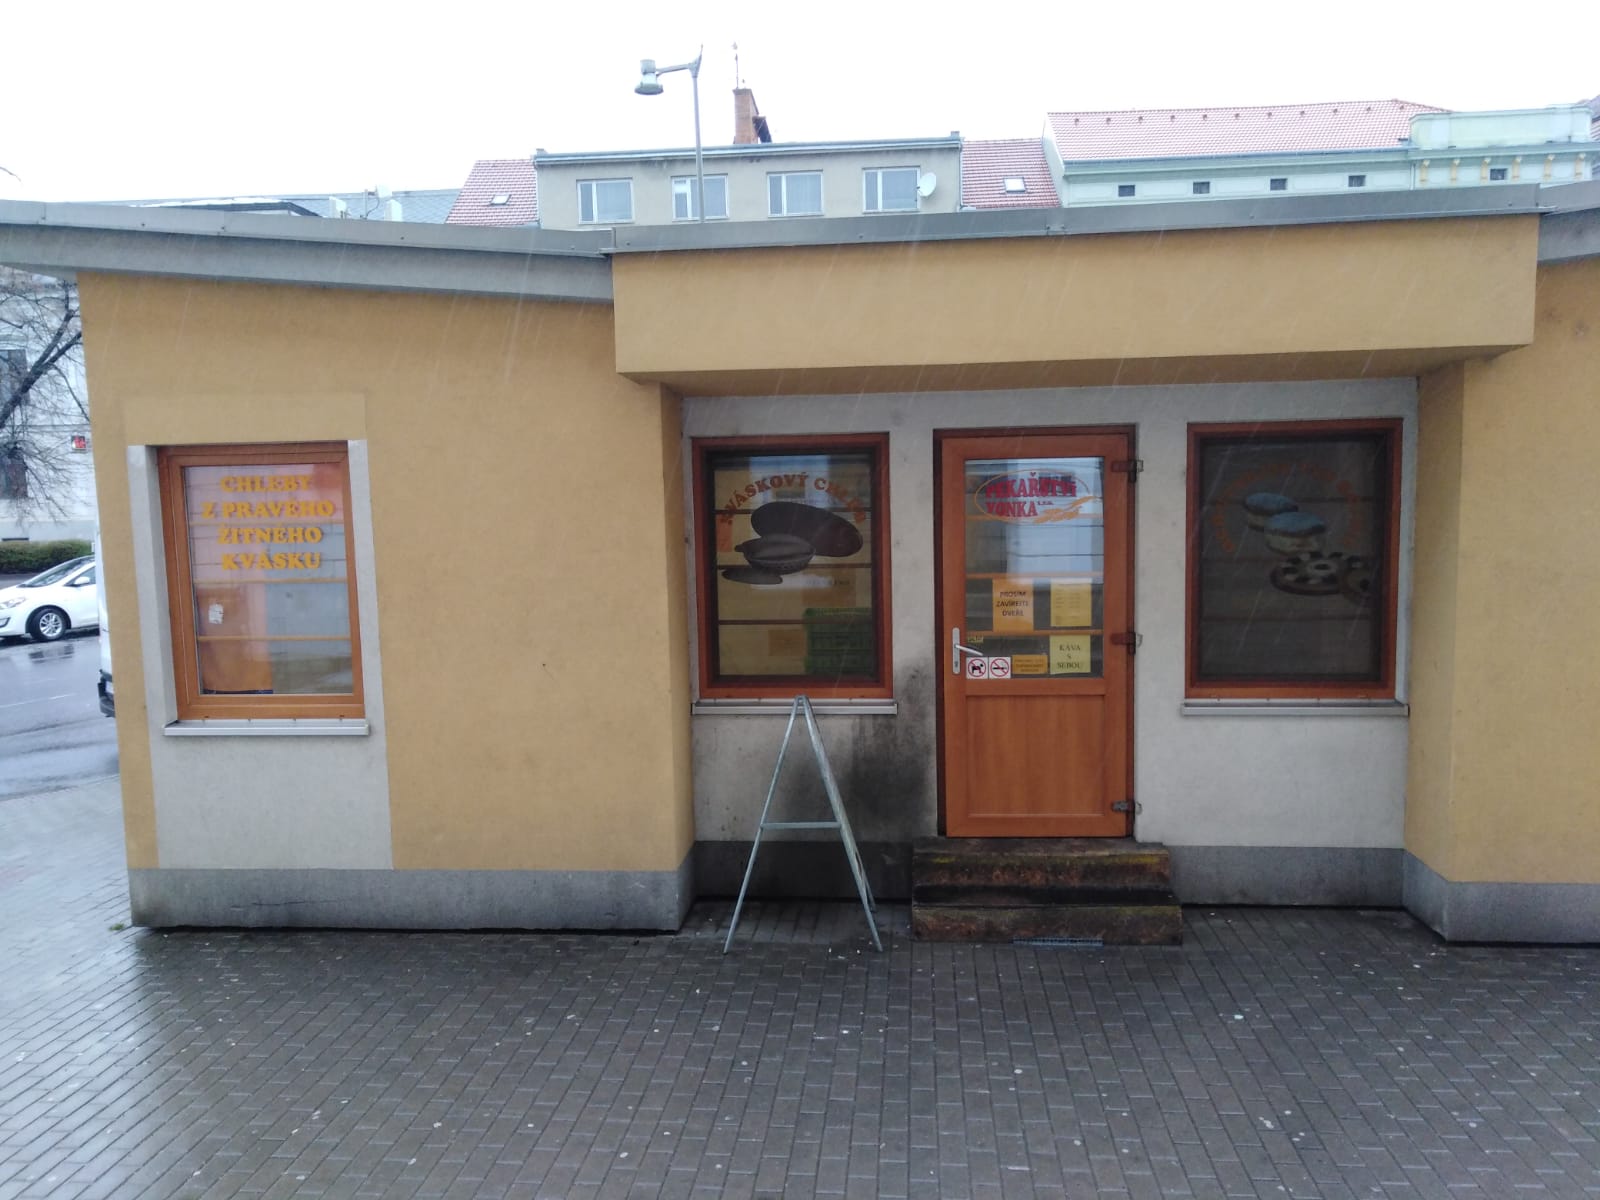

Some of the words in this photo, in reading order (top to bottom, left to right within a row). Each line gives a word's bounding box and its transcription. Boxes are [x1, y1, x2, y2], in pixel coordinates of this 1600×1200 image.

[221, 475, 312, 492] CHLEBY
[985, 471, 1077, 498] PEKAŘSTVÍ
[202, 502, 218, 519] Z
[222, 498, 336, 519] PRAVÉHO
[985, 501, 1038, 518] VONKA
[217, 522, 324, 545] ŽITNÉHO
[222, 550, 322, 571] KVÁSKU
